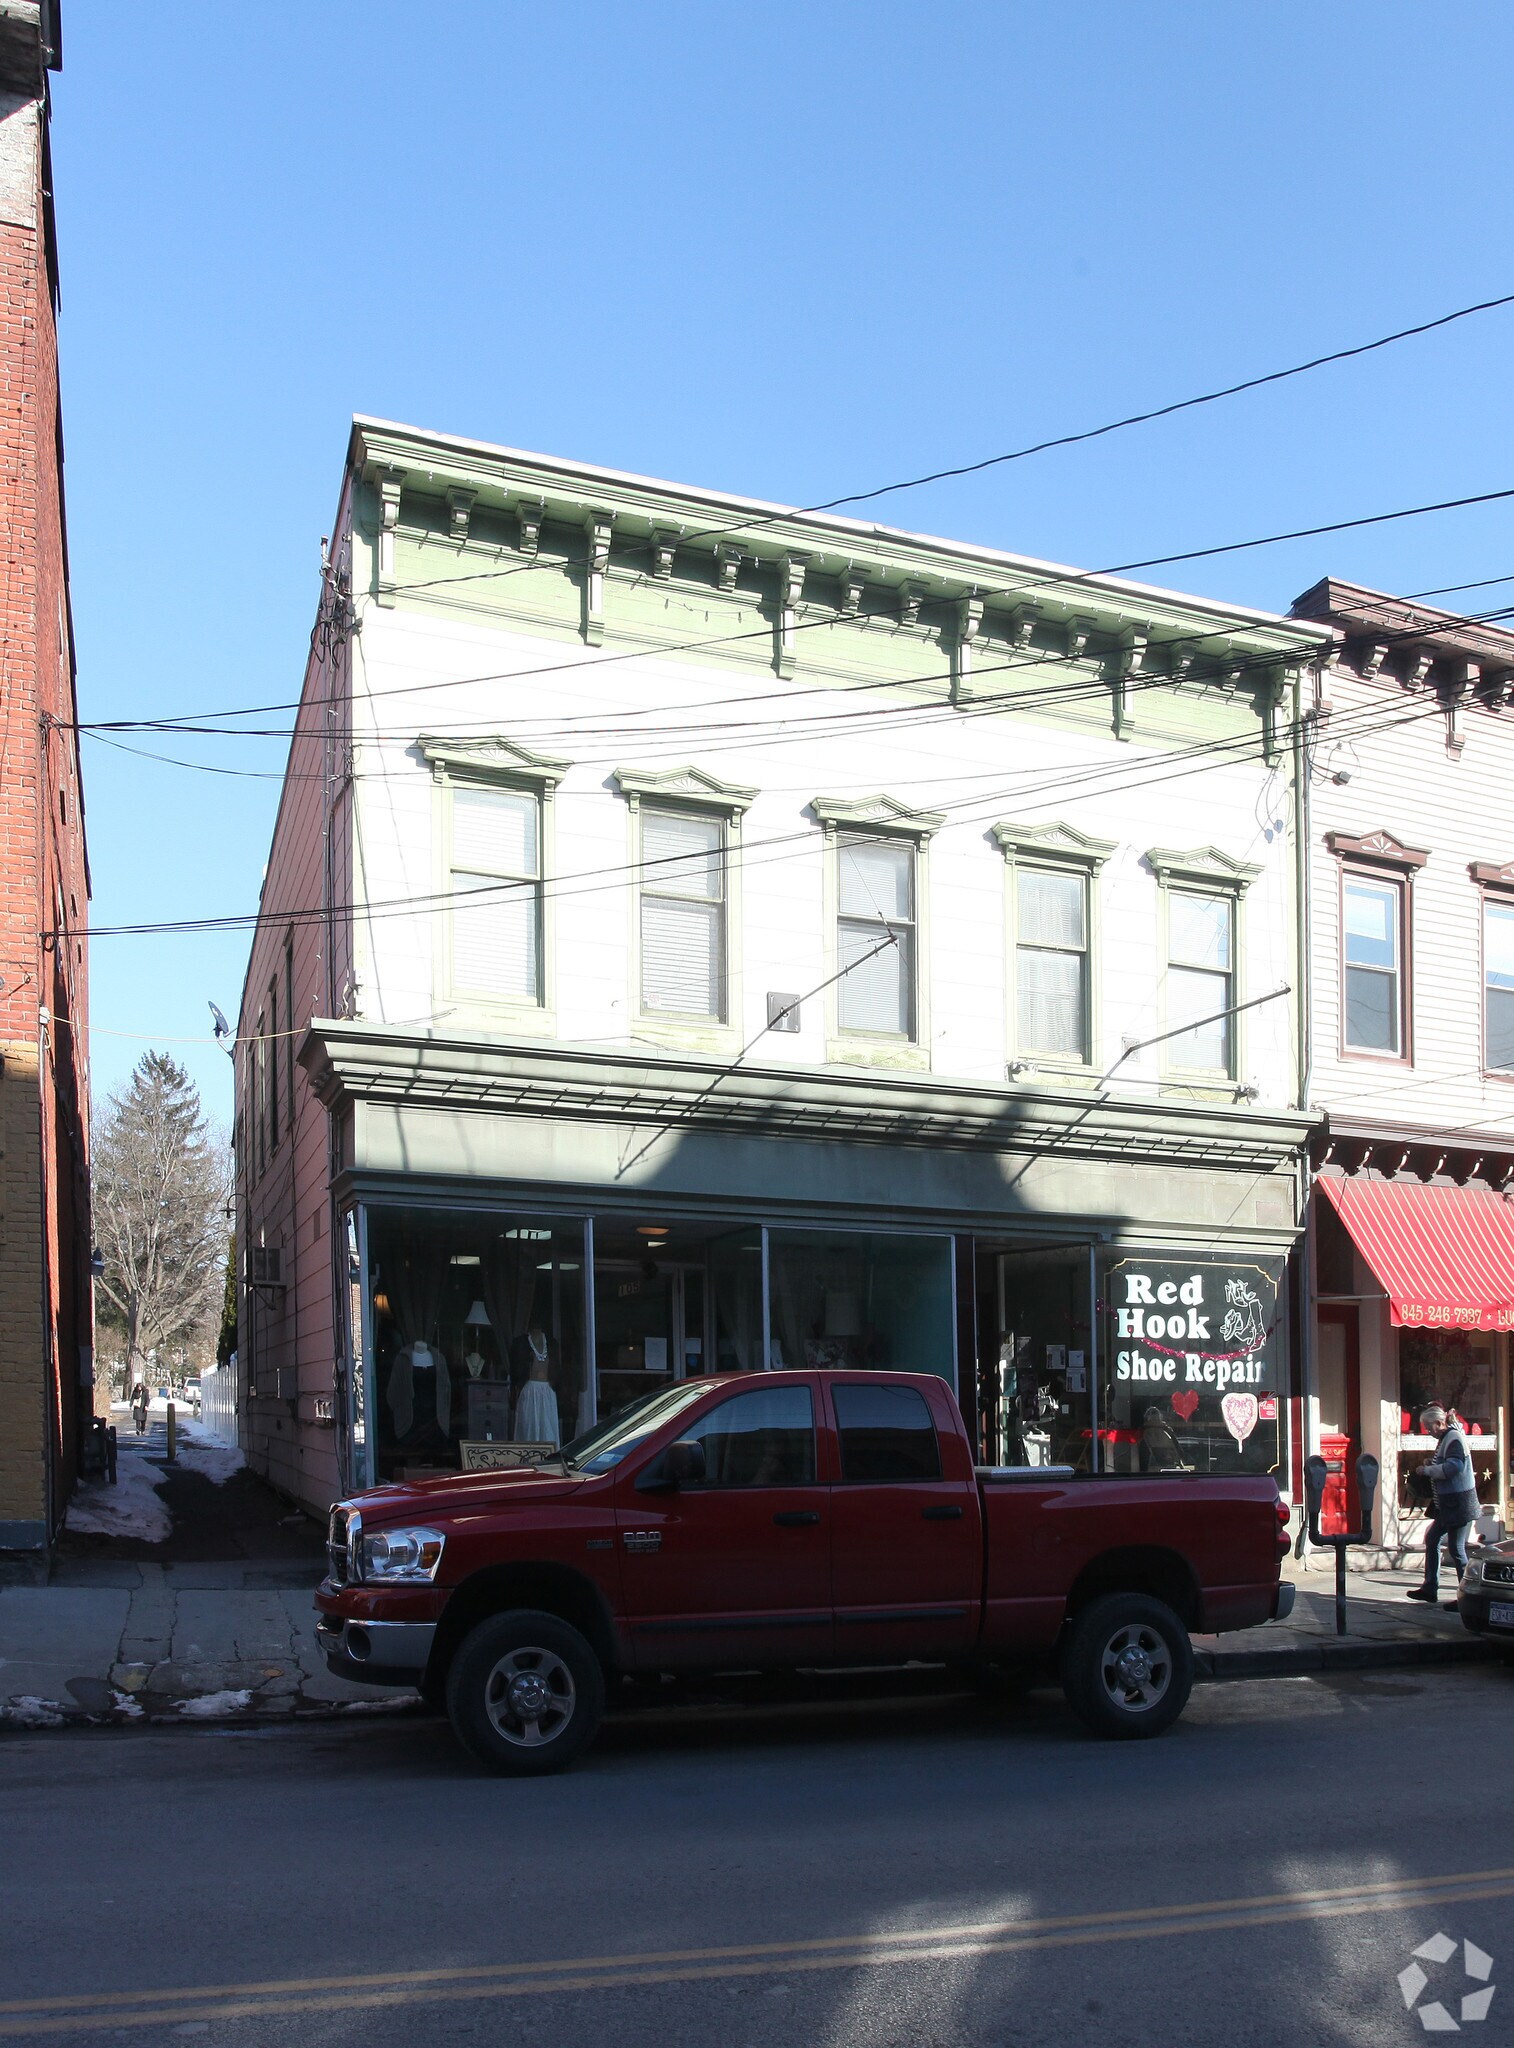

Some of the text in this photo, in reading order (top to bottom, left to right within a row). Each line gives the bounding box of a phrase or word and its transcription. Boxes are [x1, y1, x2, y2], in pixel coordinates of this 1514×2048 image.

[619, 1281, 640, 1296] 105
[1125, 1274, 1205, 1305] Red
[1116, 1308, 1211, 1339] Hook
[1401, 1303, 1514, 1326] 845-246-7337 LU
[1116, 1350, 1267, 1391] Shoe Repair
